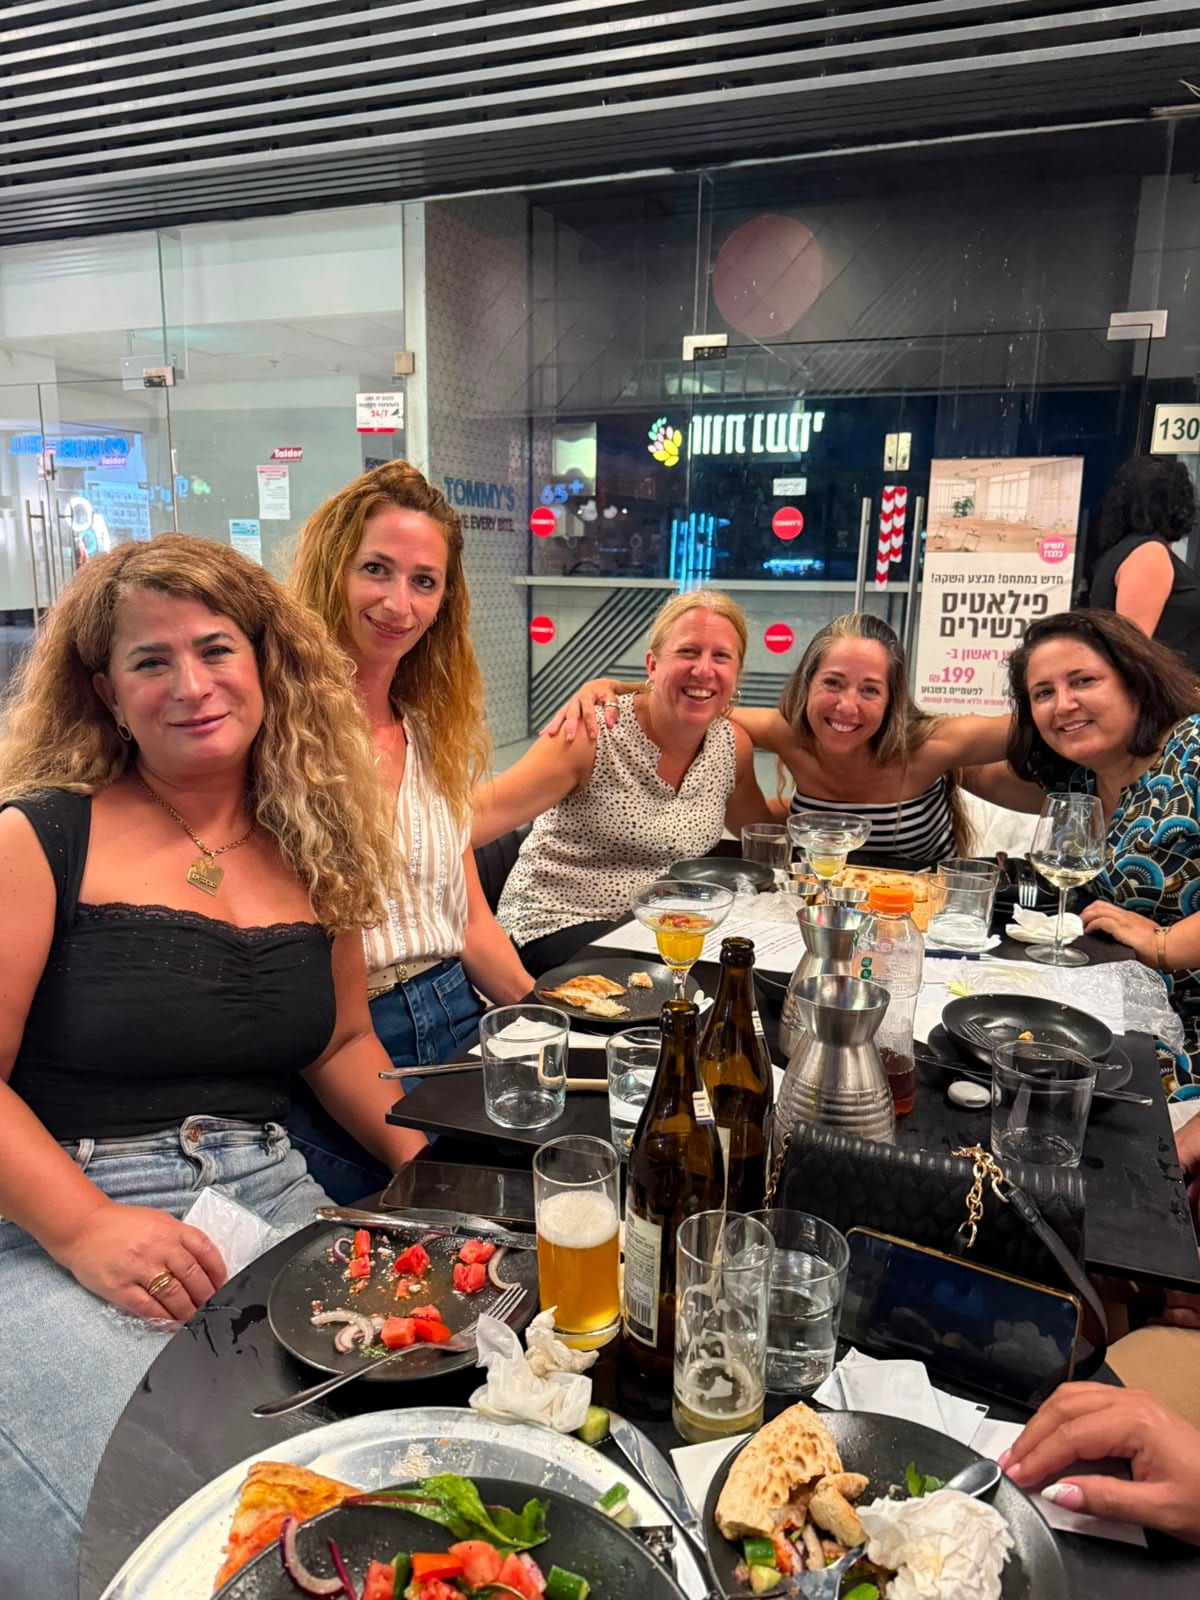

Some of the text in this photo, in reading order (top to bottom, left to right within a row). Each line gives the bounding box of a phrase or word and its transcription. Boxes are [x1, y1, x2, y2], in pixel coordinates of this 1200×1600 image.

[1160, 417, 1200, 440] 130
[444, 476, 515, 512] TOMMY'S
[470, 515, 496, 531] EVERY
[931, 573, 1064, 585] חדש במתחם! מבצע השקה!
[942, 590, 1049, 615] פילאטיס
[940, 617, 1032, 639] כשירים
[946, 648, 958, 659] ב-
[961, 648, 998, 661] ראשון
[921, 686, 984, 696] לפעמיים בשבוע
